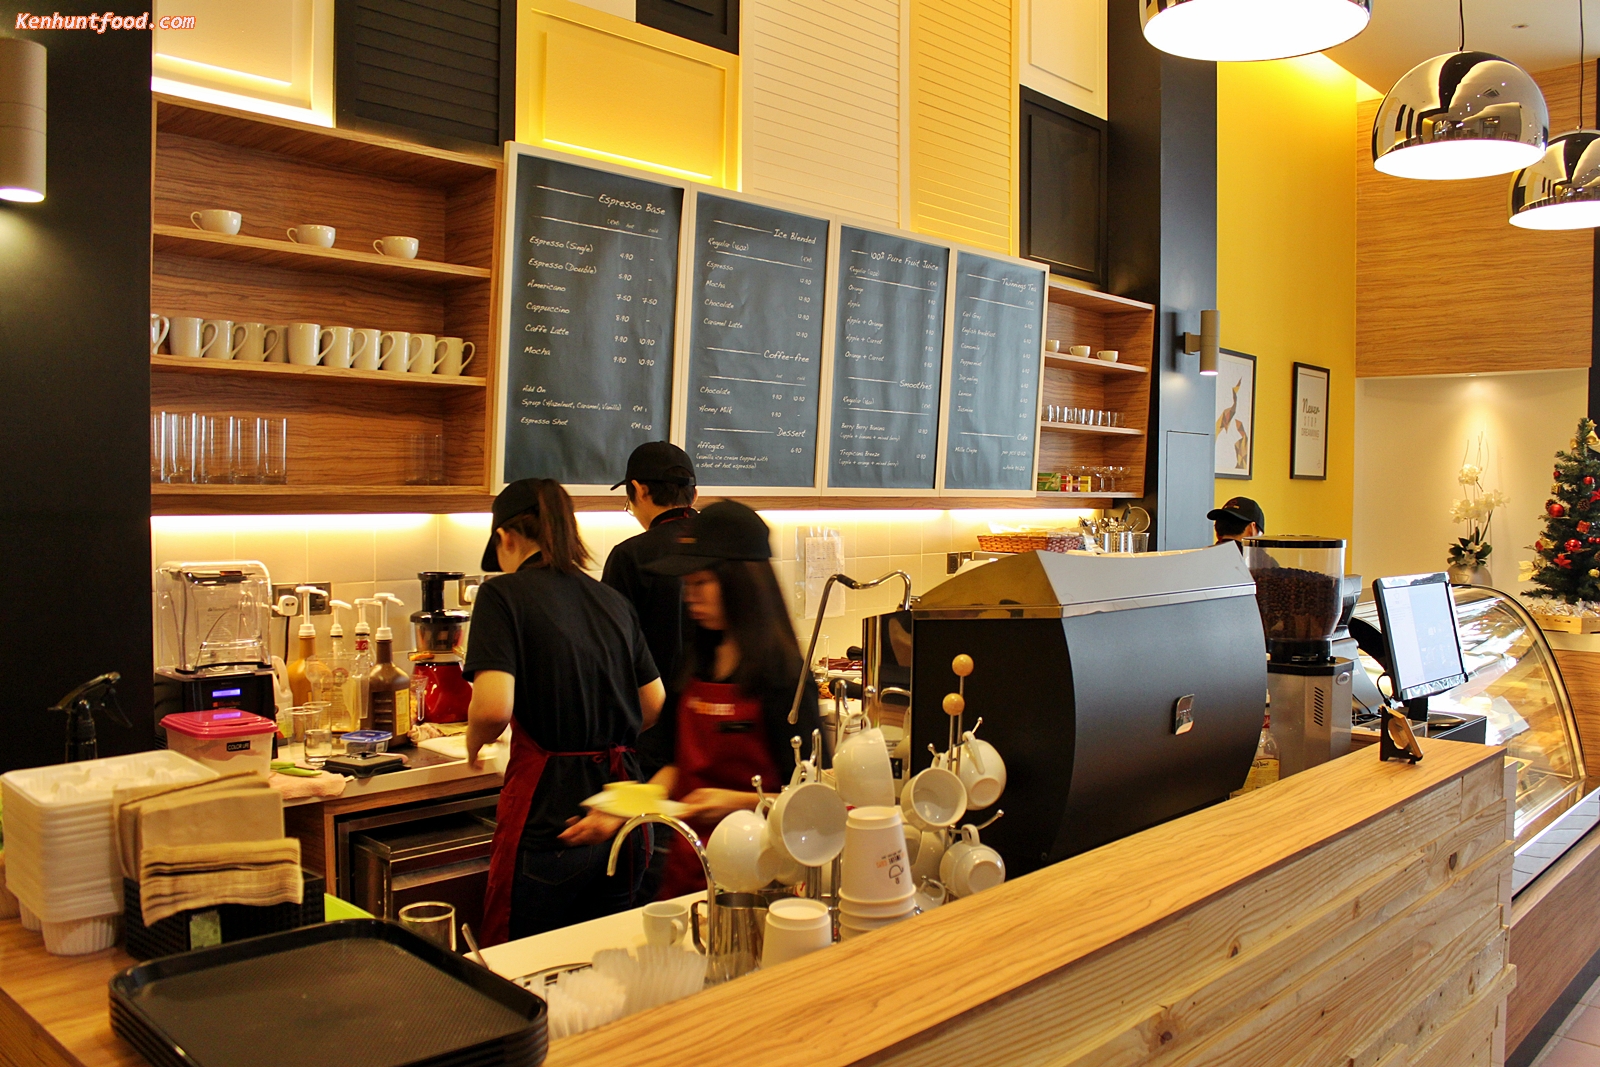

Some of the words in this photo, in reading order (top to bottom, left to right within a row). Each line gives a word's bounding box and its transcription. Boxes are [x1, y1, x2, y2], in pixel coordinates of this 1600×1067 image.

[598, 193, 642, 210] Espresso
[645, 203, 666, 215] Base
[773, 228, 788, 239] Ice
[790, 232, 817, 245] Blended
[529, 235, 564, 250] Espresso
[566, 240, 594, 255] (Single)
[708, 237, 730, 249] Regular
[528, 257, 563, 270] Espresso
[565, 262, 597, 274] (Double)
[706, 260, 734, 270] Espresso
[886, 254, 902, 264] Pure
[904, 256, 920, 268] Fruit
[922, 260, 939, 271] Juice
[527, 279, 566, 292] Americano
[706, 280, 726, 289] Mocha
[526, 302, 570, 314] Cappuccino
[704, 298, 734, 308] Chocolate
[704, 318, 726, 326] Caramel
[728, 320, 743, 329] Latte
[524, 324, 547, 334] Caffe
[550, 326, 570, 336] Latte
[524, 346, 551, 356] Mocha
[764, 350, 810, 363] Coffee-free
[700, 386, 730, 395] Chocolate
[900, 380, 932, 390] Smoothies
[522, 398, 541, 408] Syrup
[698, 404, 718, 414] Honey
[720, 406, 733, 414] Milk
[520, 416, 550, 426] Espresso
[776, 427, 806, 438] Dessert
[697, 441, 725, 452] Affogato
